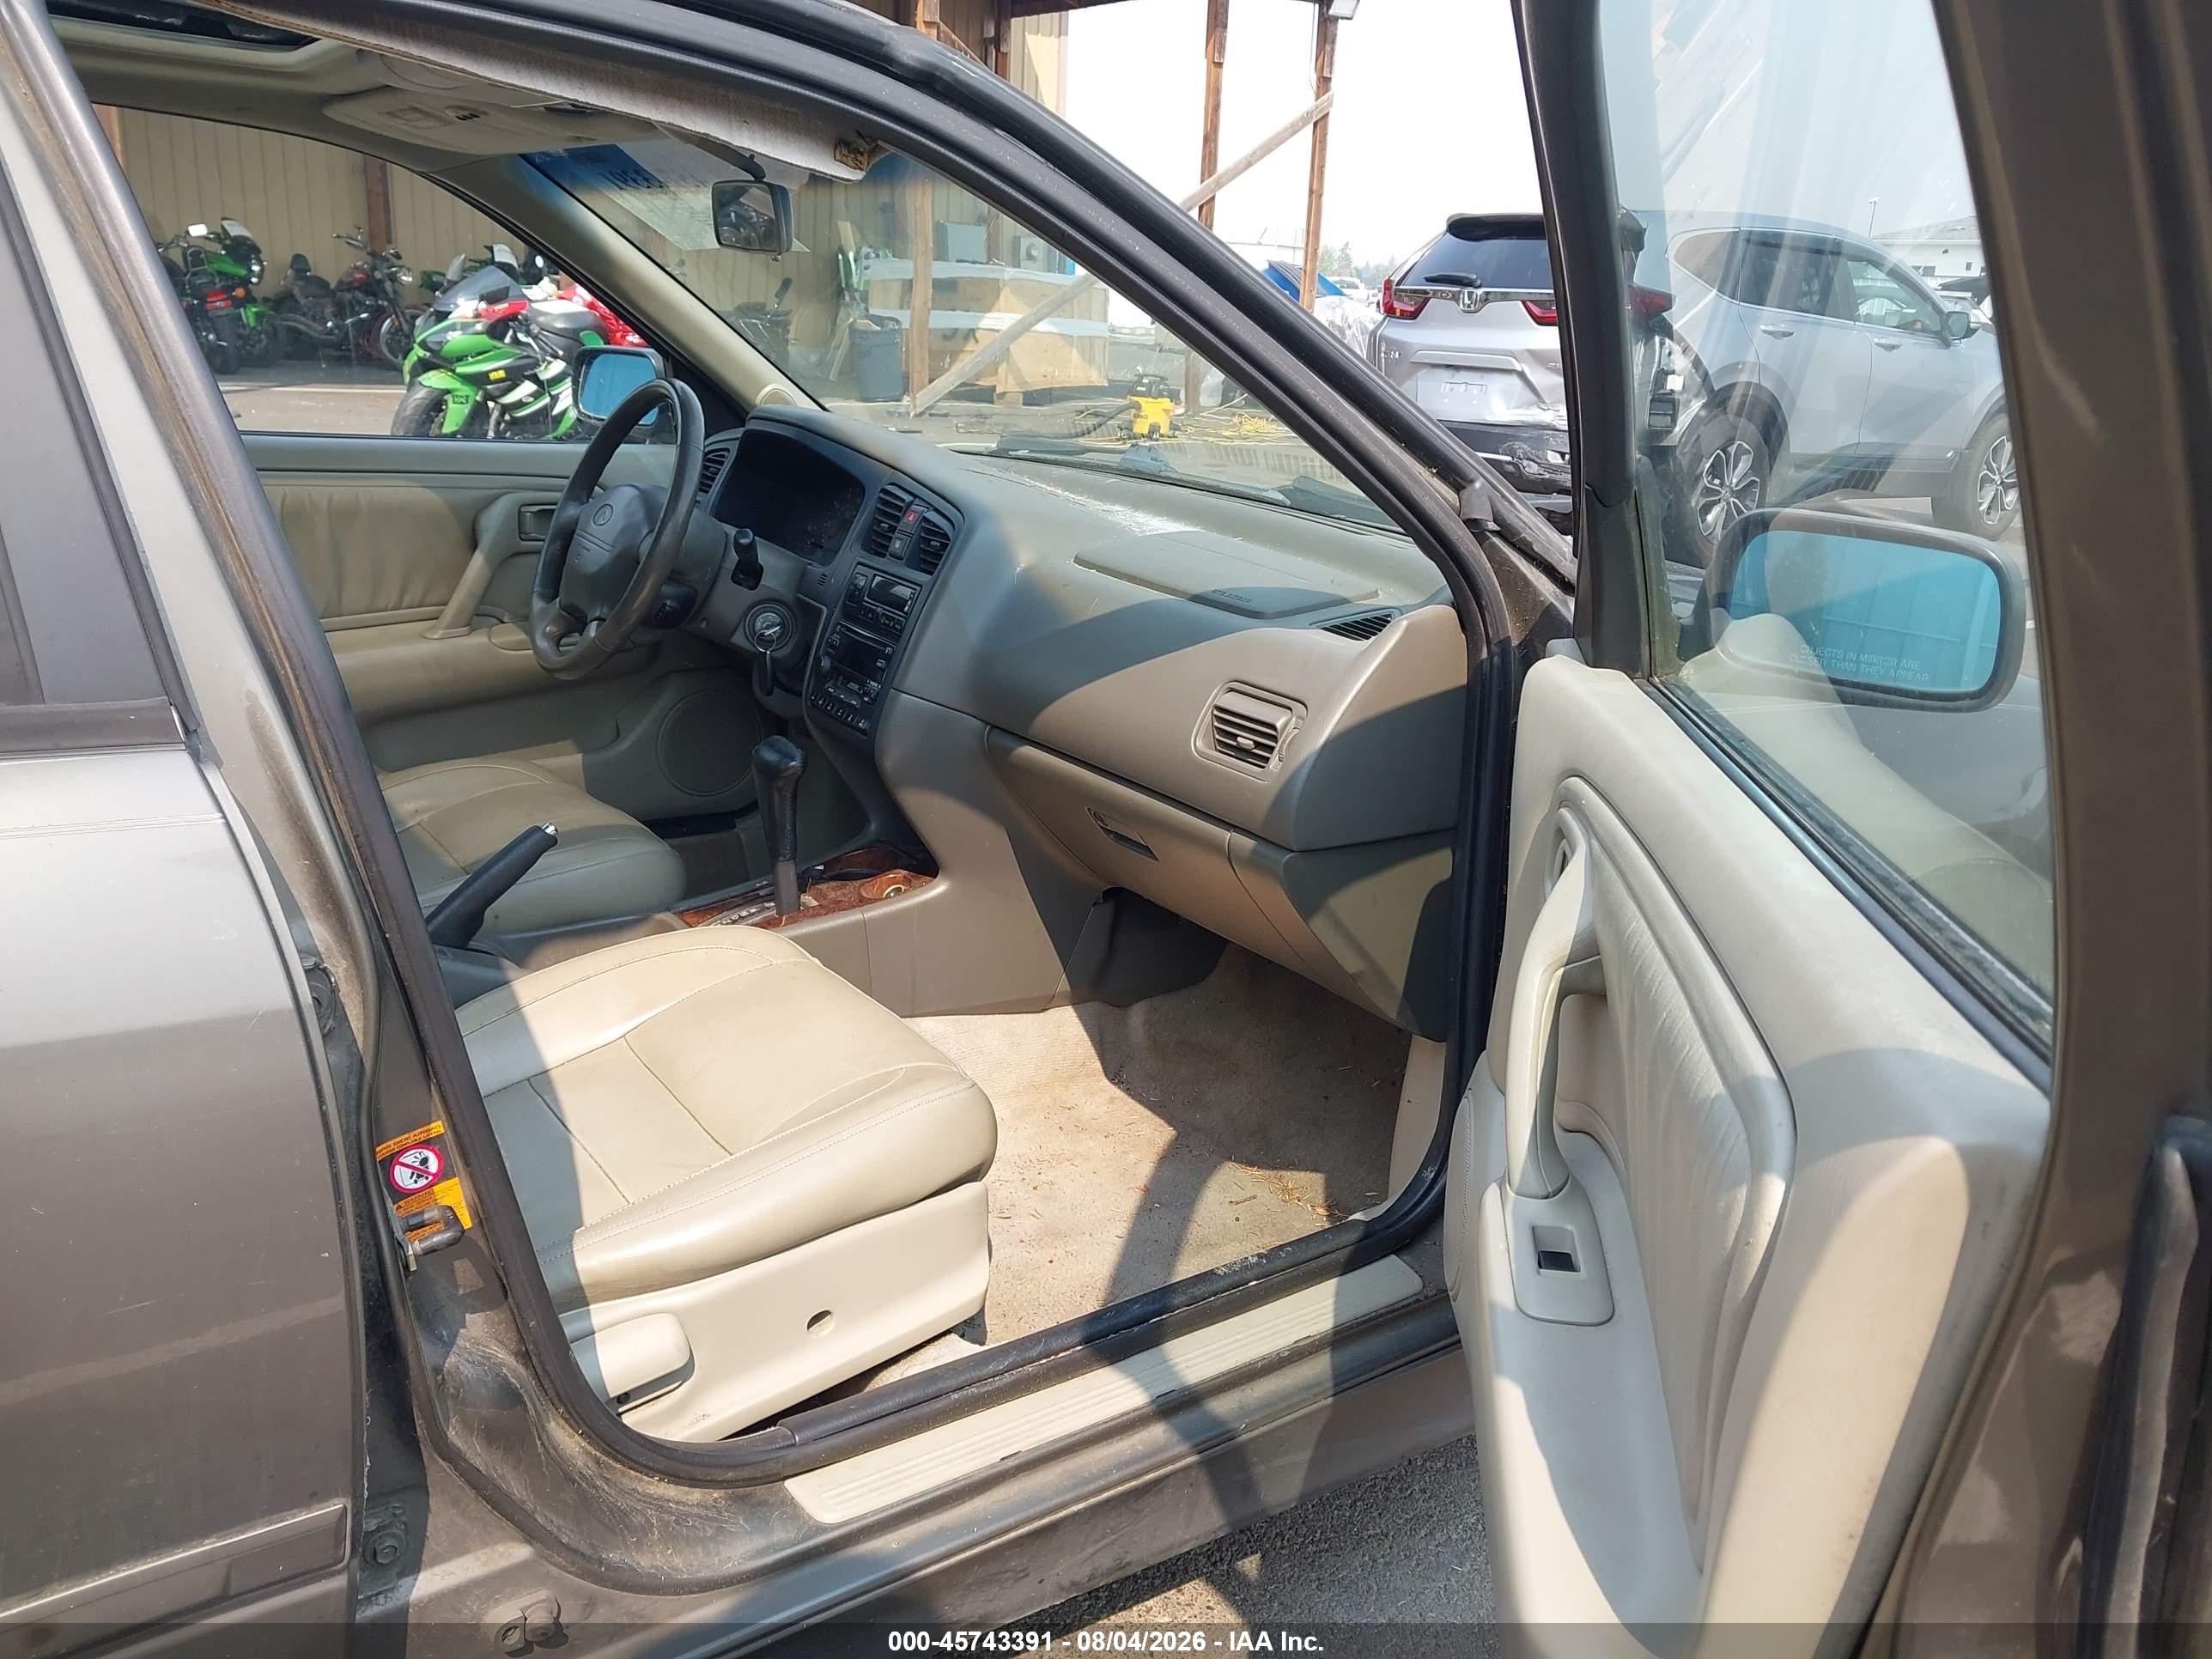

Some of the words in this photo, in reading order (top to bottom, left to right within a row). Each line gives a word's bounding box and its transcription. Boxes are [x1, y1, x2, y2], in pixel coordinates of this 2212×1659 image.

[1789, 653, 1827, 667] CLOSER
[1832, 660, 1856, 672] THAN
[1860, 665, 1884, 676] THEY
[1888, 670, 1930, 681] APPEAR
[1846, 651, 1856, 660] IN
[1858, 653, 1897, 666] MIRROR
[1899, 659, 1922, 670] ARE
[404, 1188, 434, 1206] WARNING
